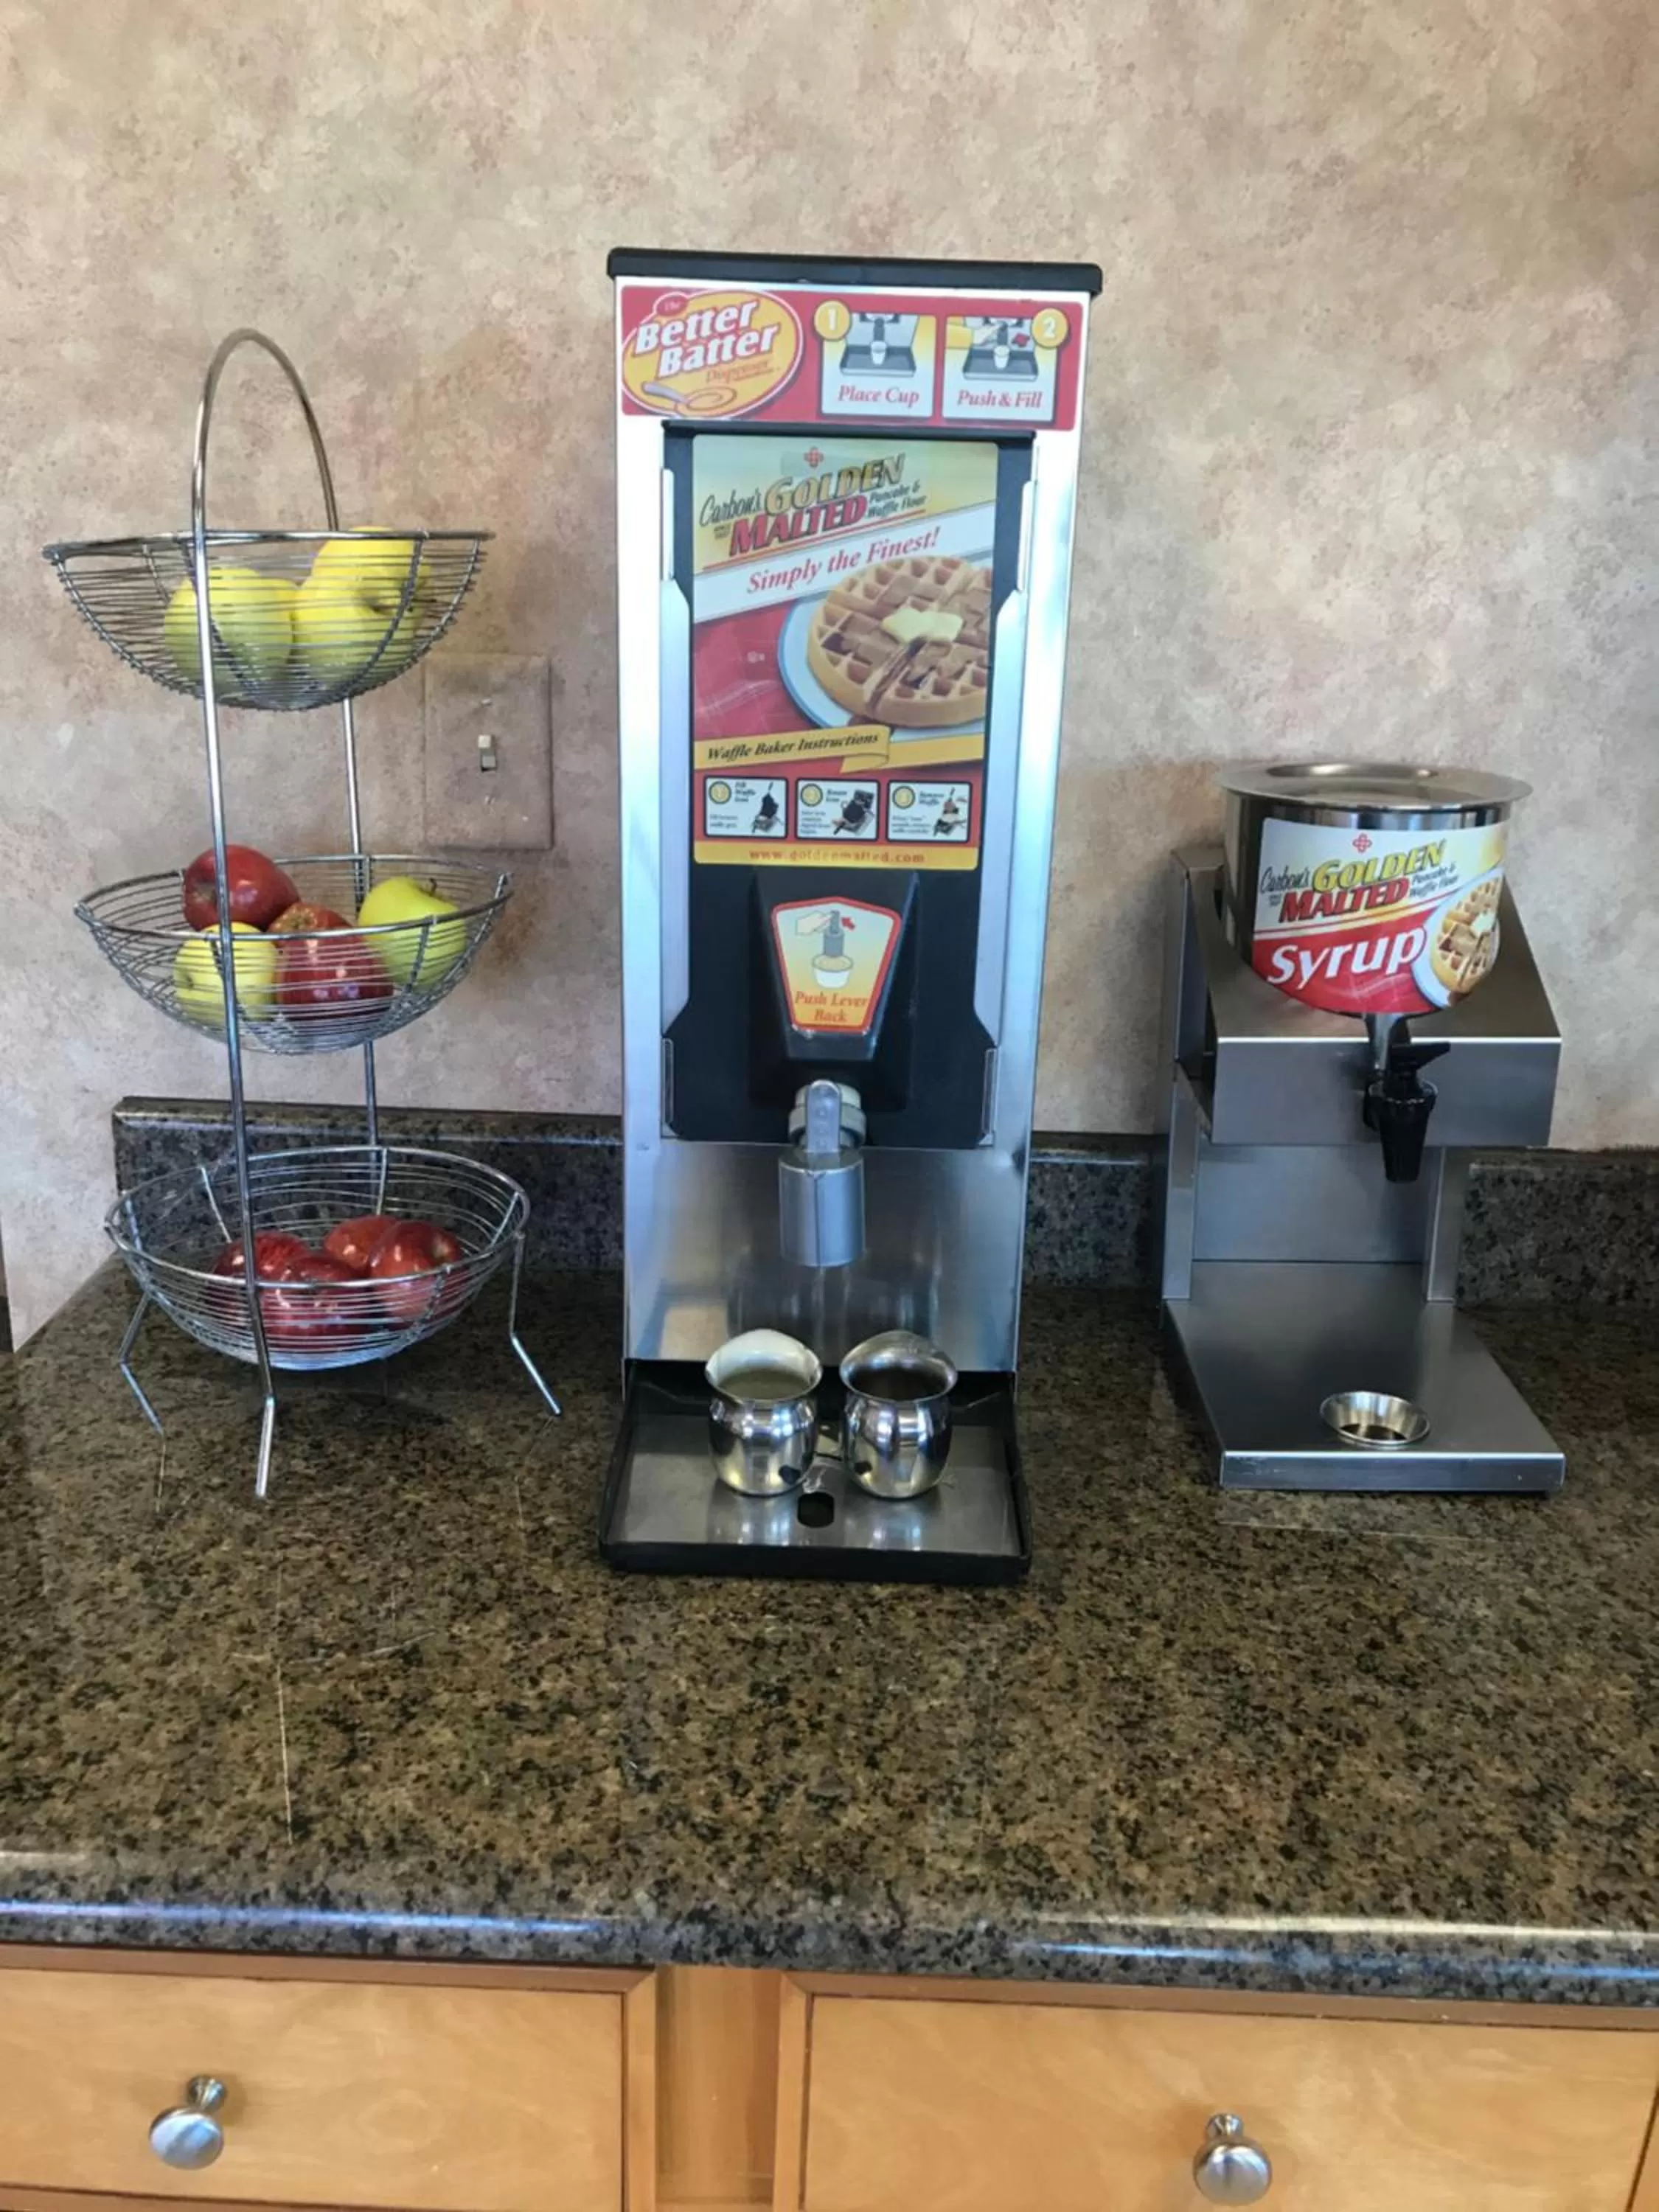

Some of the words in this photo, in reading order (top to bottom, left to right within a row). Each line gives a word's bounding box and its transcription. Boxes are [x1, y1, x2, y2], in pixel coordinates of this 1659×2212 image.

[633, 298, 761, 357] Better
[827, 308, 837, 331] 1
[1042, 316, 1059, 338] 2
[655, 322, 782, 379] Batter
[838, 384, 883, 403] Place
[885, 386, 920, 408] Cup
[957, 389, 996, 407] Push
[998, 393, 1012, 407] &
[1014, 390, 1043, 408] Fill
[699, 487, 762, 527] Carbon's
[764, 453, 907, 515] GOLDEN
[728, 494, 869, 557] MALTED
[747, 558, 822, 594] Simply
[827, 546, 863, 574] the
[866, 526, 941, 563] Finest!
[707, 745, 753, 762] Waffle
[754, 740, 796, 757] Baker
[796, 731, 880, 751] Instructions
[1311, 838, 1446, 892] GOLDEN
[1278, 875, 1411, 924] MALTED
[1267, 928, 1424, 990] Syrup
[795, 990, 827, 1005] Push
[830, 992, 868, 1007] Lever
